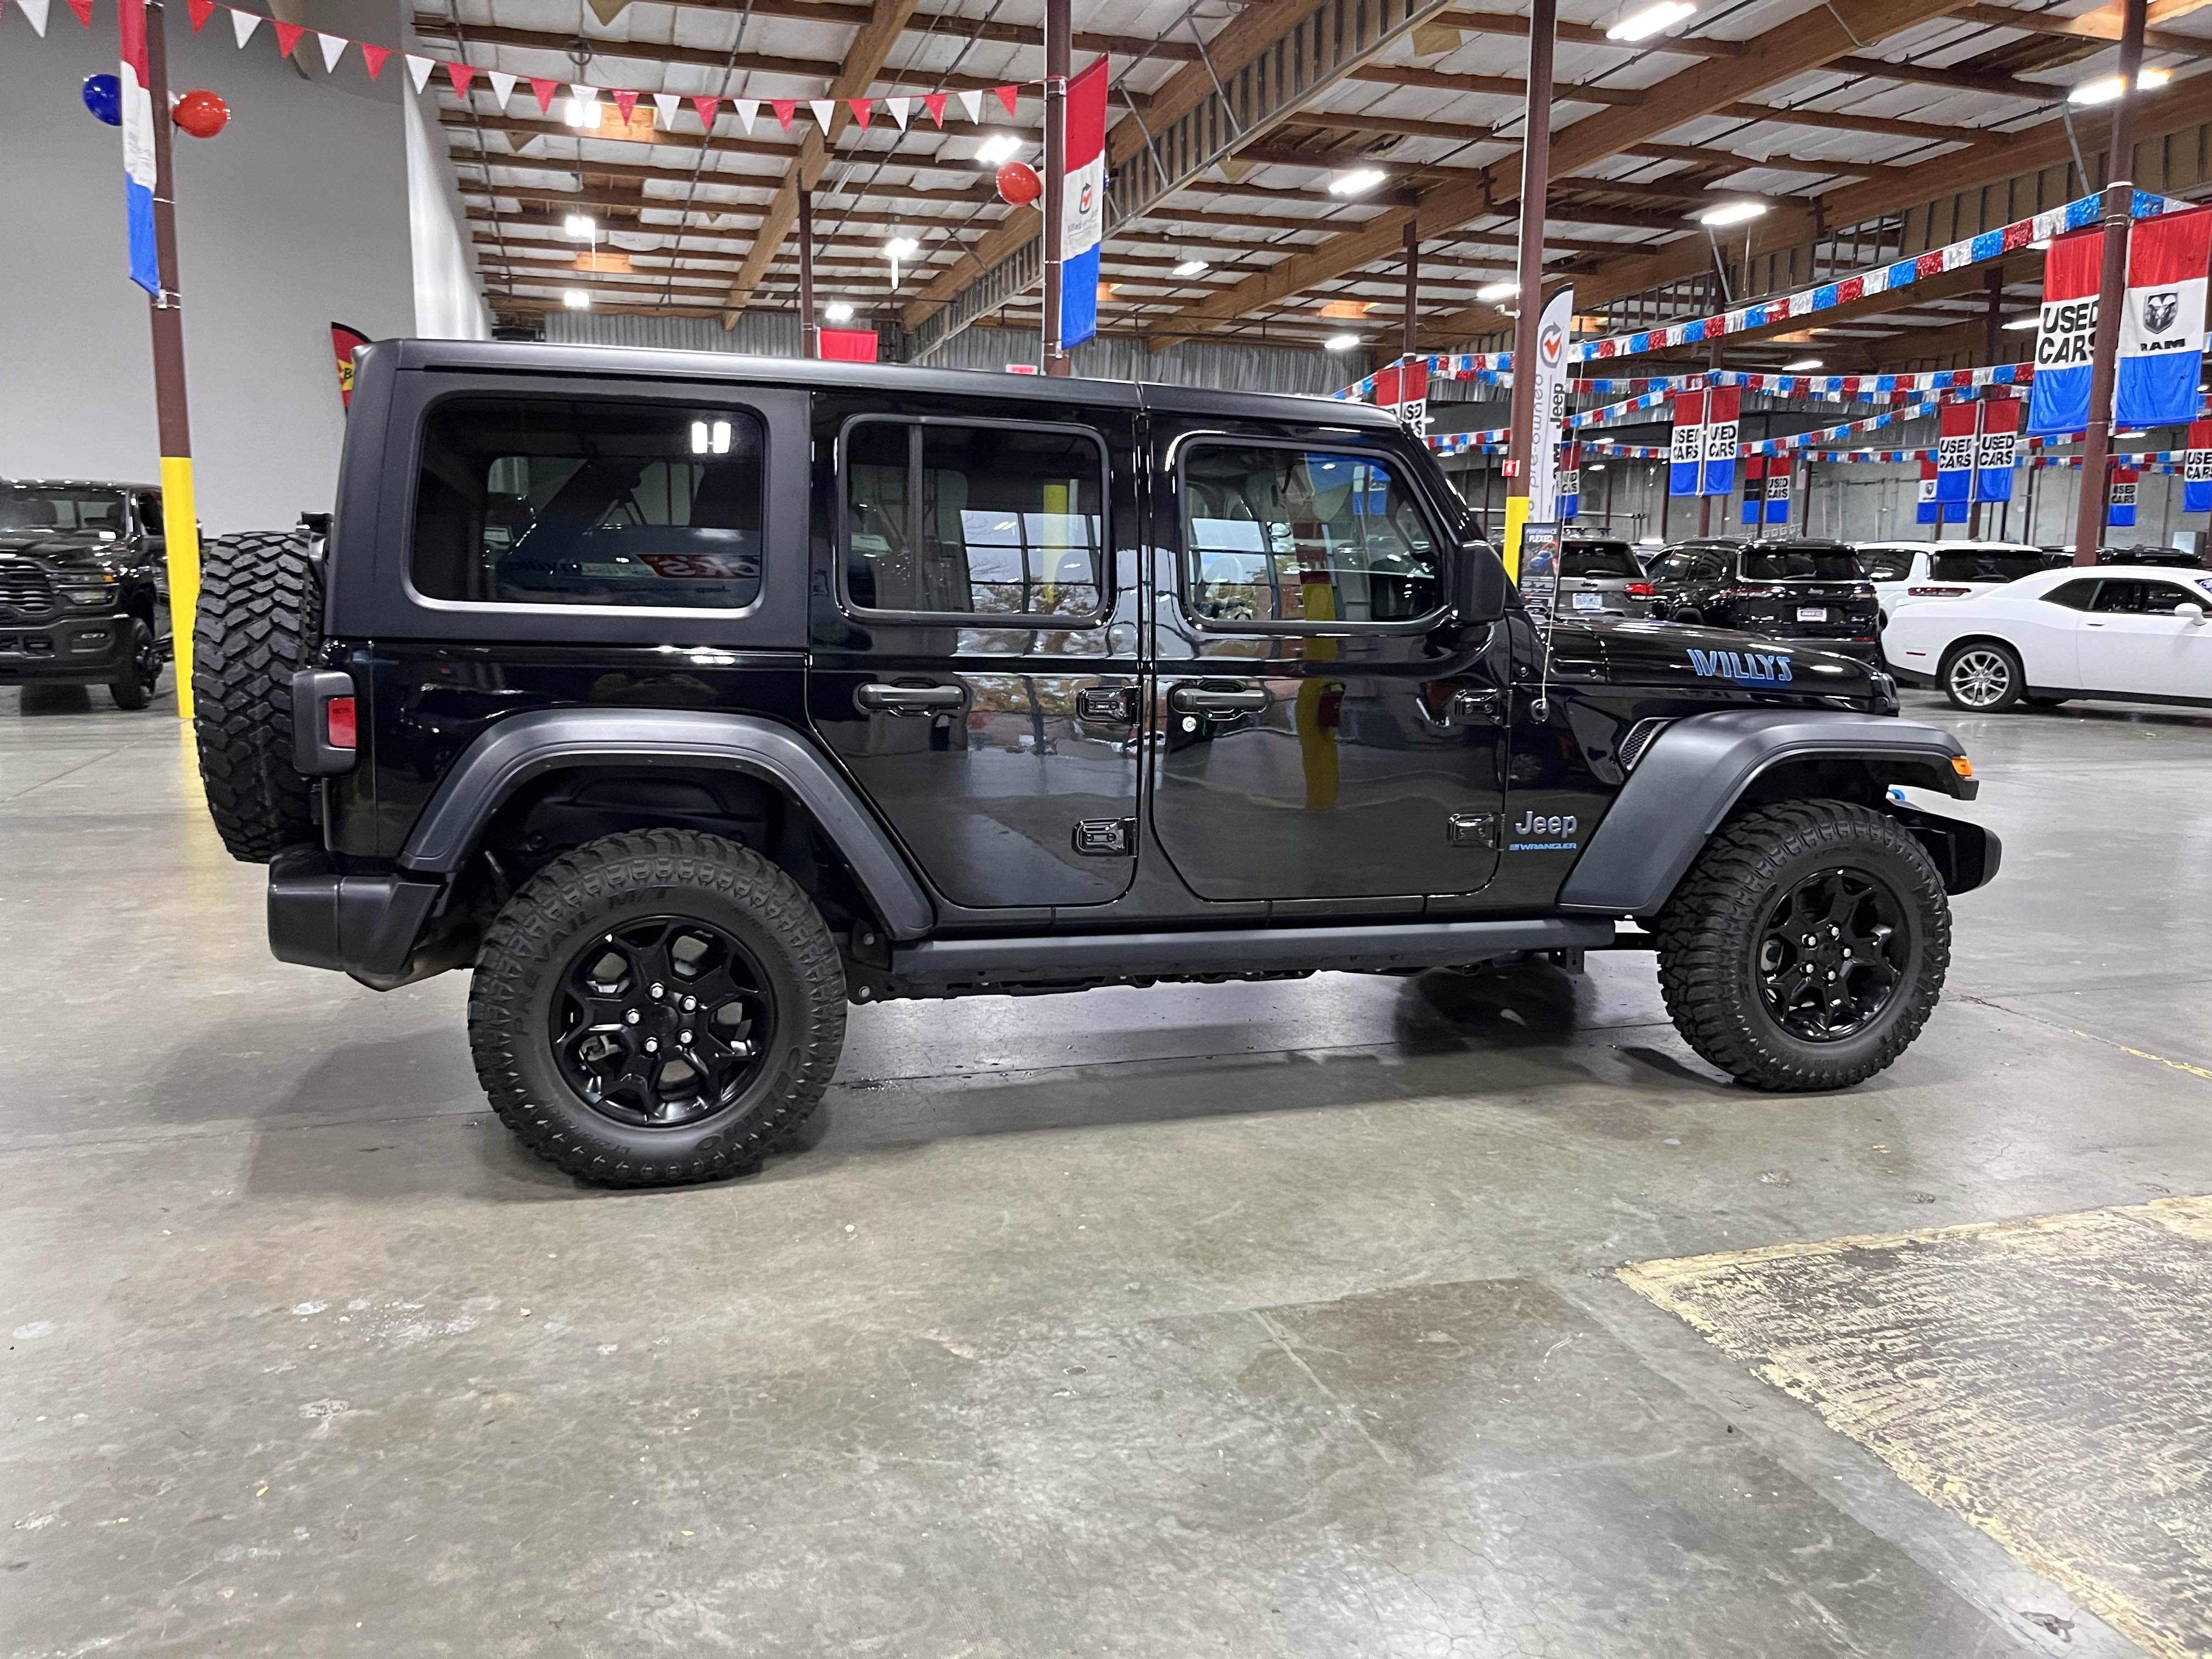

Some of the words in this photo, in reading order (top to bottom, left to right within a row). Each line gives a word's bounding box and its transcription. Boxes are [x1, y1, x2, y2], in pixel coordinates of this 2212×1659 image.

[2042, 300, 2100, 334] USED
[2140, 338, 2186, 352] RAM
[1550, 383, 1565, 429] Jeep
[1711, 425, 1736, 441] UED
[1982, 435, 2015, 450] USED
[1939, 454, 1971, 469] CARS
[1979, 450, 2013, 466] CARS
[2187, 452, 2212, 465] USE
[1686, 648, 1792, 681] WILLYS
[1515, 811, 1577, 838] Jeep
